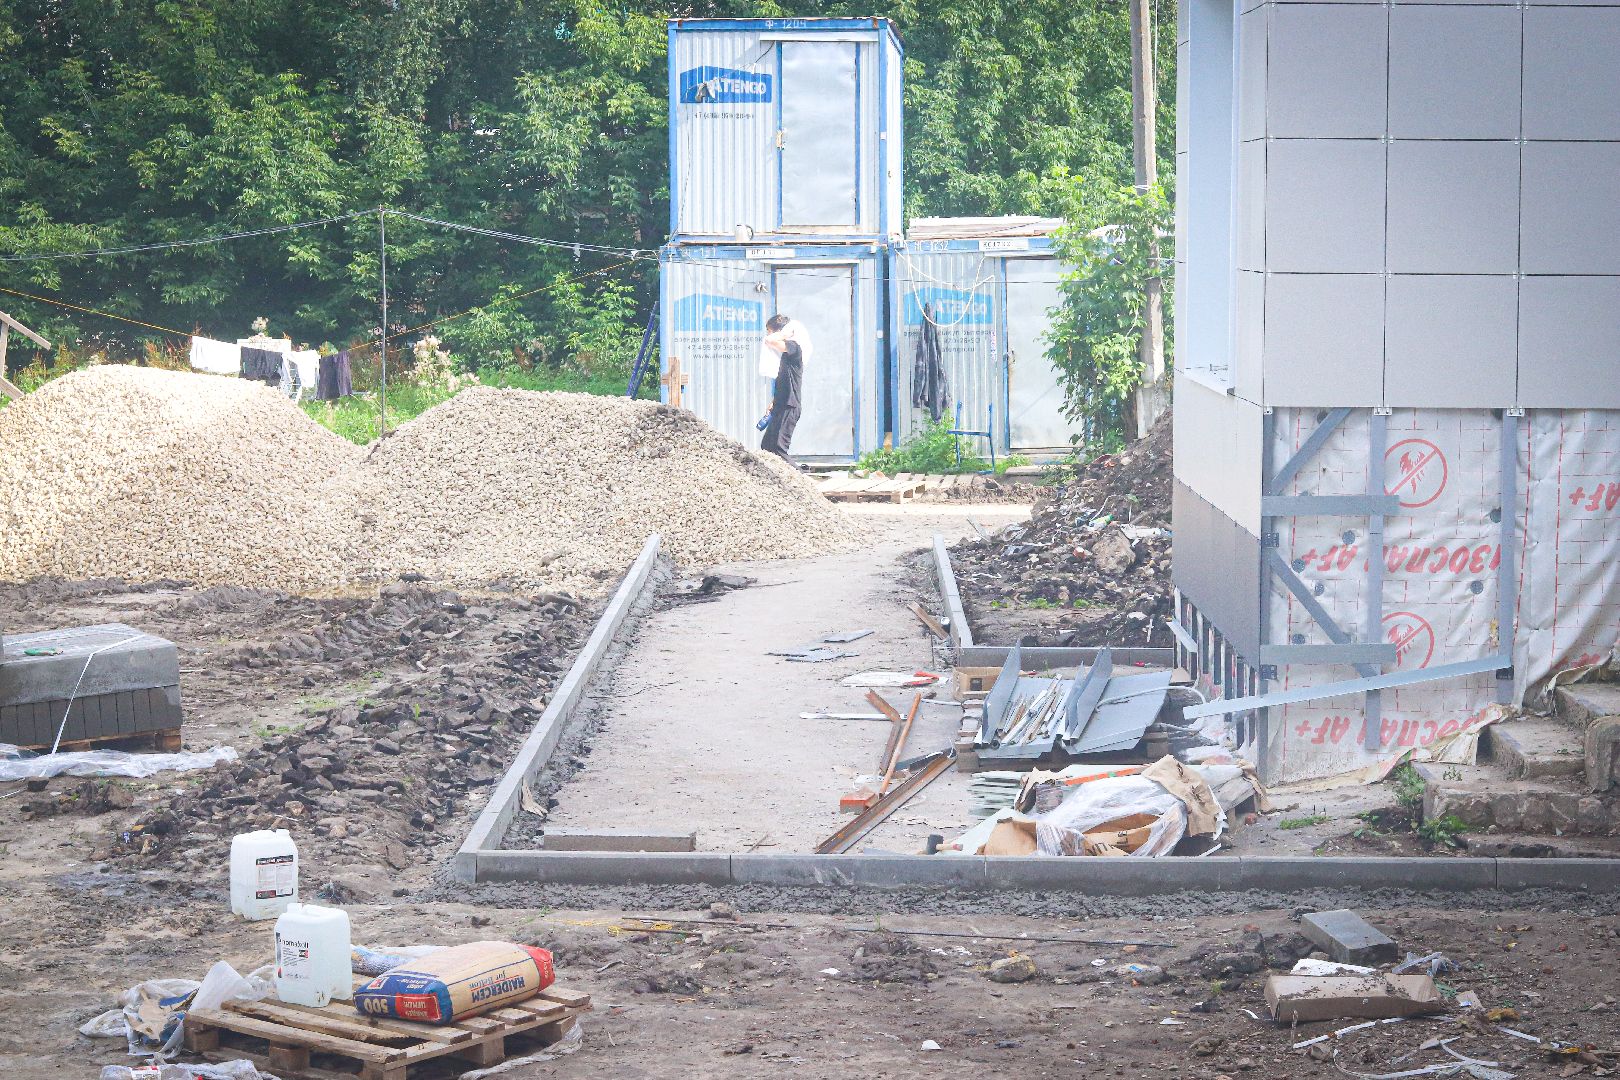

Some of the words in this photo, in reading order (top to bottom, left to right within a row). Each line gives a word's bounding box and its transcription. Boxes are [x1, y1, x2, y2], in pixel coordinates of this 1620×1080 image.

[708, 76, 767, 95] ATENGO
[703, 304, 758, 322] ATENGO
[936, 297, 988, 315] ATENGO
[1295, 716, 1351, 746] AF+
[471, 976, 526, 1004] HAIDERCEM
[363, 998, 389, 1014] 500
